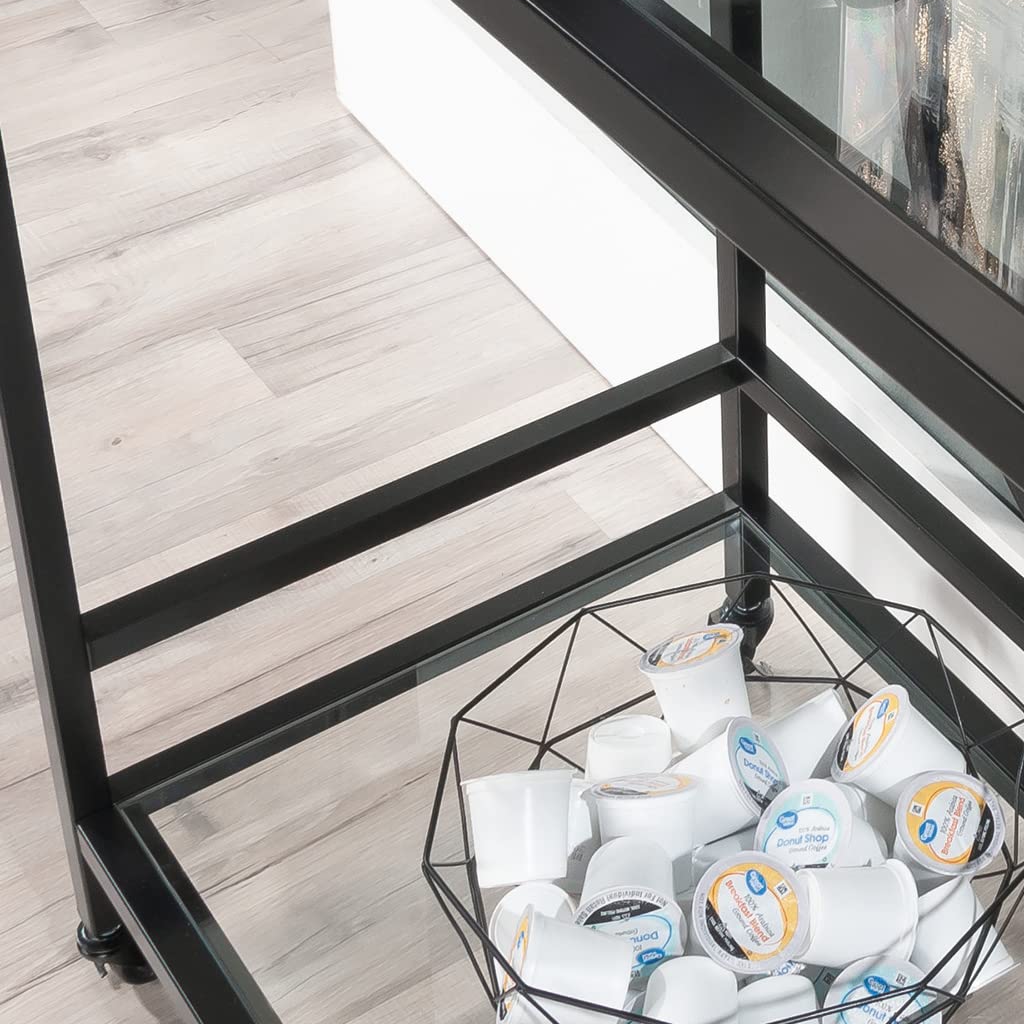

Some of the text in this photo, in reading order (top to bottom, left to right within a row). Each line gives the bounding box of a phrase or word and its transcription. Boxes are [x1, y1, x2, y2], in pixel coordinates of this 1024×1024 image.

[941, 796, 966, 855] Breakfast Blend
[776, 833, 829, 848] Donut Shop
[606, 890, 643, 901] Individual
[656, 897, 668, 907] Not
[725, 879, 754, 919] Breakfast
[749, 919, 770, 943] Blend
